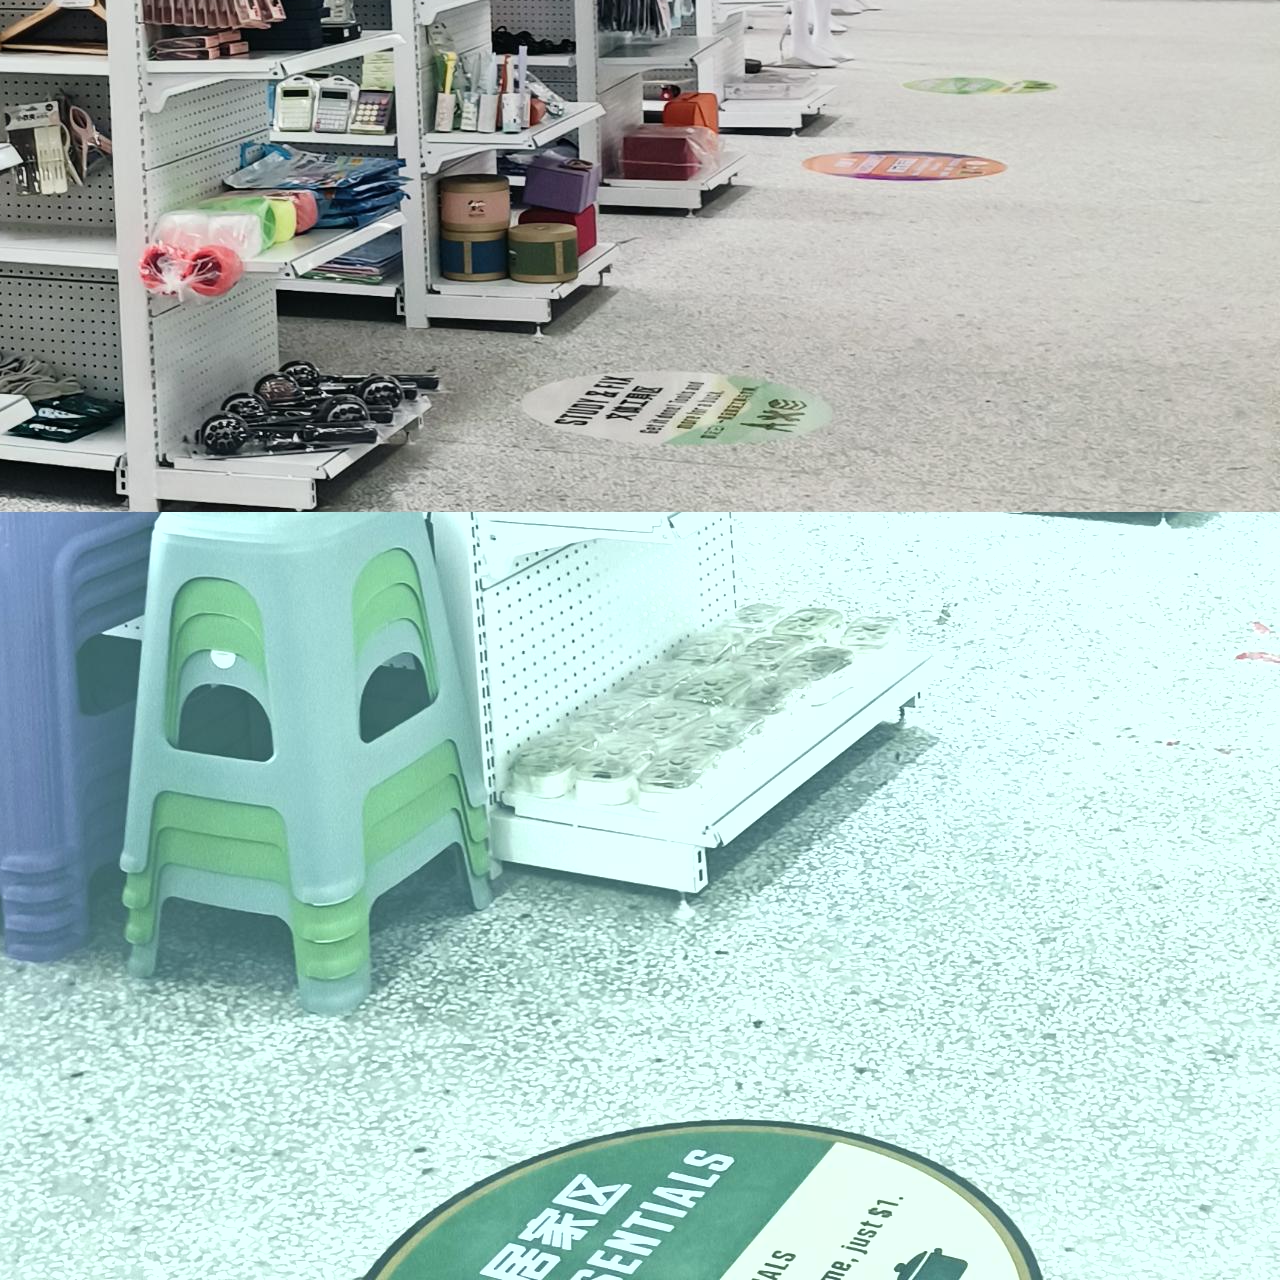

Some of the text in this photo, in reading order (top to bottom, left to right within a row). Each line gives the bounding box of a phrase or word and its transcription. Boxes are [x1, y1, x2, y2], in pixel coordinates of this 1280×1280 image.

[554, 375, 635, 426] STUDY & FIX
[605, 385, 663, 421] 文工具区
[480, 1173, 632, 1280] 居家区
[841, 1220, 884, 1255] just
[868, 1196, 904, 1218] $1.
